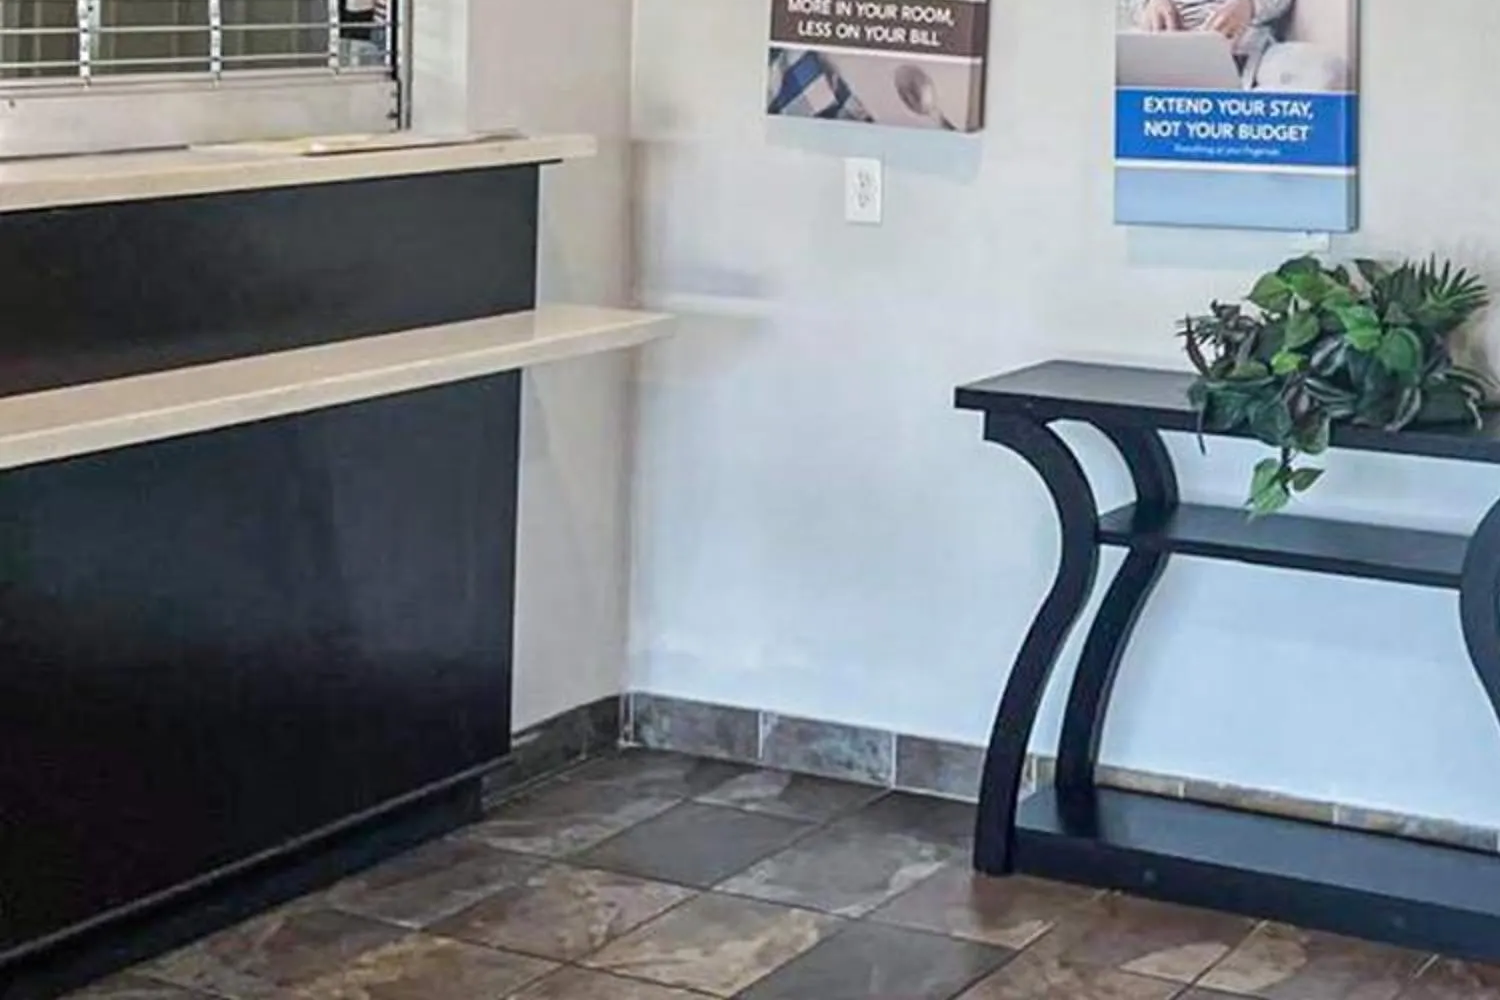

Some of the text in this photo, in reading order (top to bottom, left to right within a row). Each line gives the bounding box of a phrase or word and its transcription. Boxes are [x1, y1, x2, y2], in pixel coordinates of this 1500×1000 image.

[836, 0, 851, 16] IN
[856, 1, 897, 20] YOUR
[902, 5, 954, 26] ROOM,
[798, 20, 941, 46] LESS ON YOUR BILL
[1143, 96, 1313, 119] EXTEND YOUR STAY,
[1144, 121, 1308, 142] NOT YOUR BUDGET
